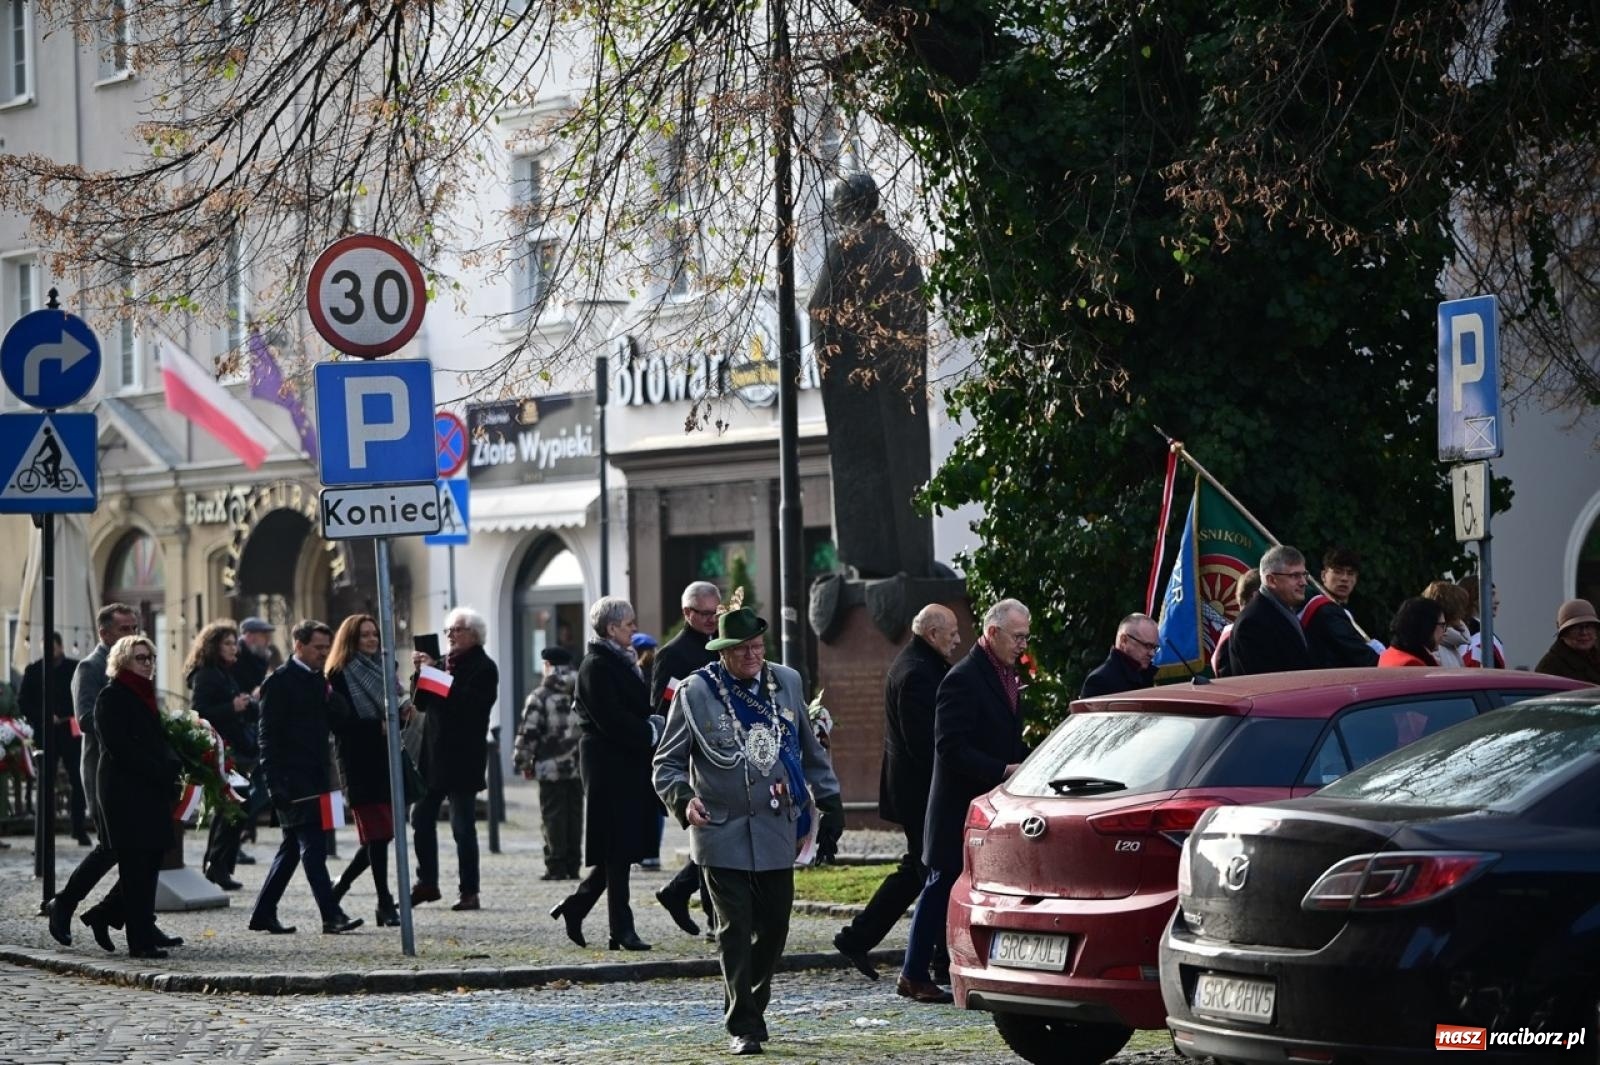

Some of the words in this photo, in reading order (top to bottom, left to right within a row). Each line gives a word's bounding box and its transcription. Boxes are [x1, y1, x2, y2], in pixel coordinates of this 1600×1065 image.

[329, 269, 409, 325] 30
[613, 335, 726, 406] Browar
[1451, 313, 1485, 412] P
[344, 375, 411, 469] P
[518, 424, 592, 470] Wypieki
[324, 495, 437, 527] Koniec
[999, 934, 1029, 961] SRC
[1202, 979, 1233, 1009] SRC
